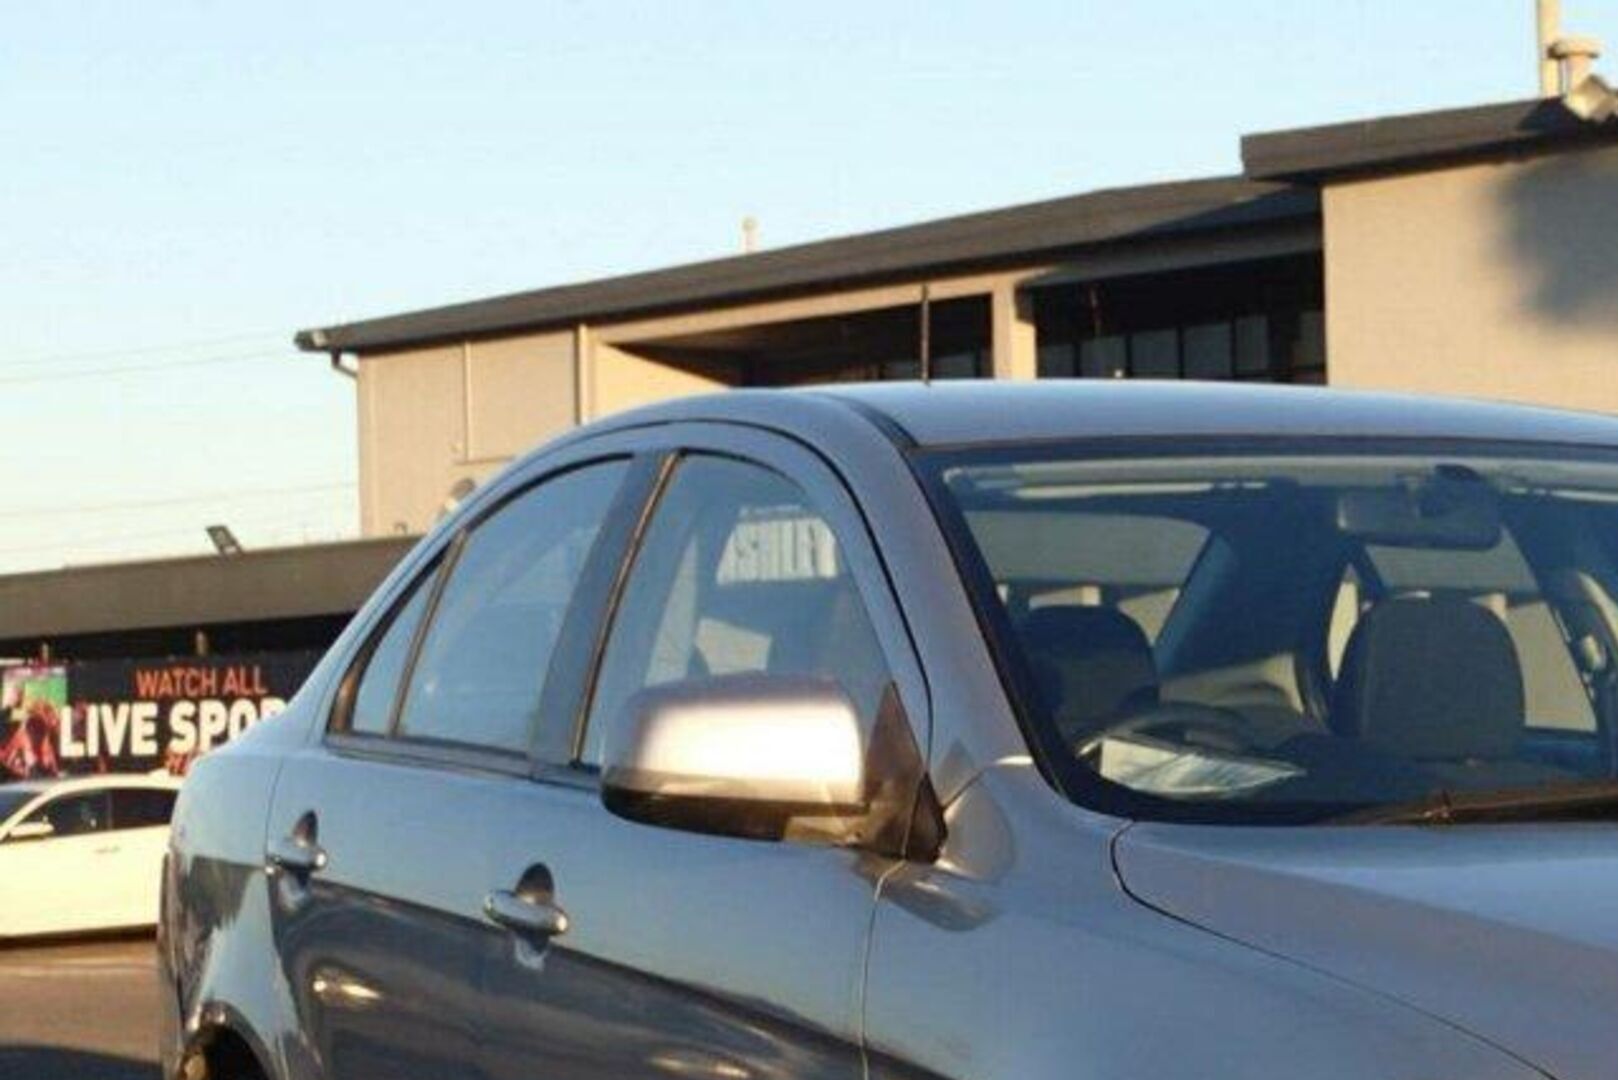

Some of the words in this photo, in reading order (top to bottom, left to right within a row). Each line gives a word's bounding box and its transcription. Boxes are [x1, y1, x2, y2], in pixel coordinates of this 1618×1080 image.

[135, 667, 217, 697] WATCH
[223, 665, 269, 695] ALL
[60, 702, 158, 758] LIVE
